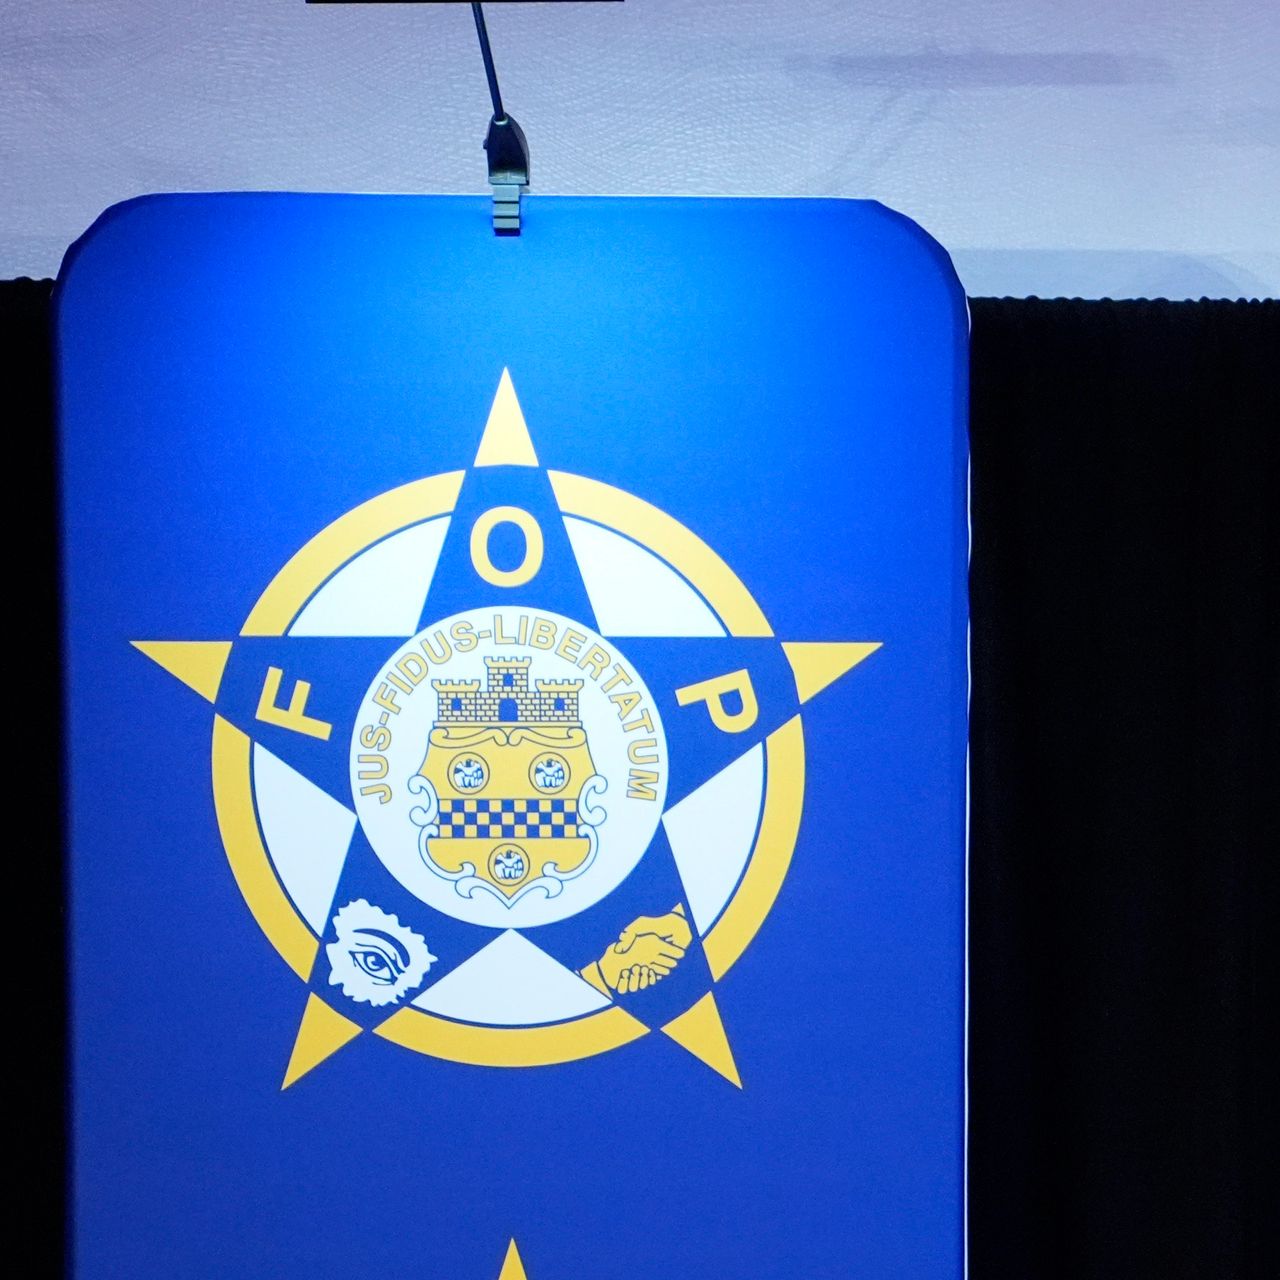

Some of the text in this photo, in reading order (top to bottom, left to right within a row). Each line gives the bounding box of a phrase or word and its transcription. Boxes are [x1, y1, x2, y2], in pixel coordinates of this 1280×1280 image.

[255, 505, 759, 742] F O P
[357, 611, 658, 806] JUS-FIDUS-LIBERTATUM
